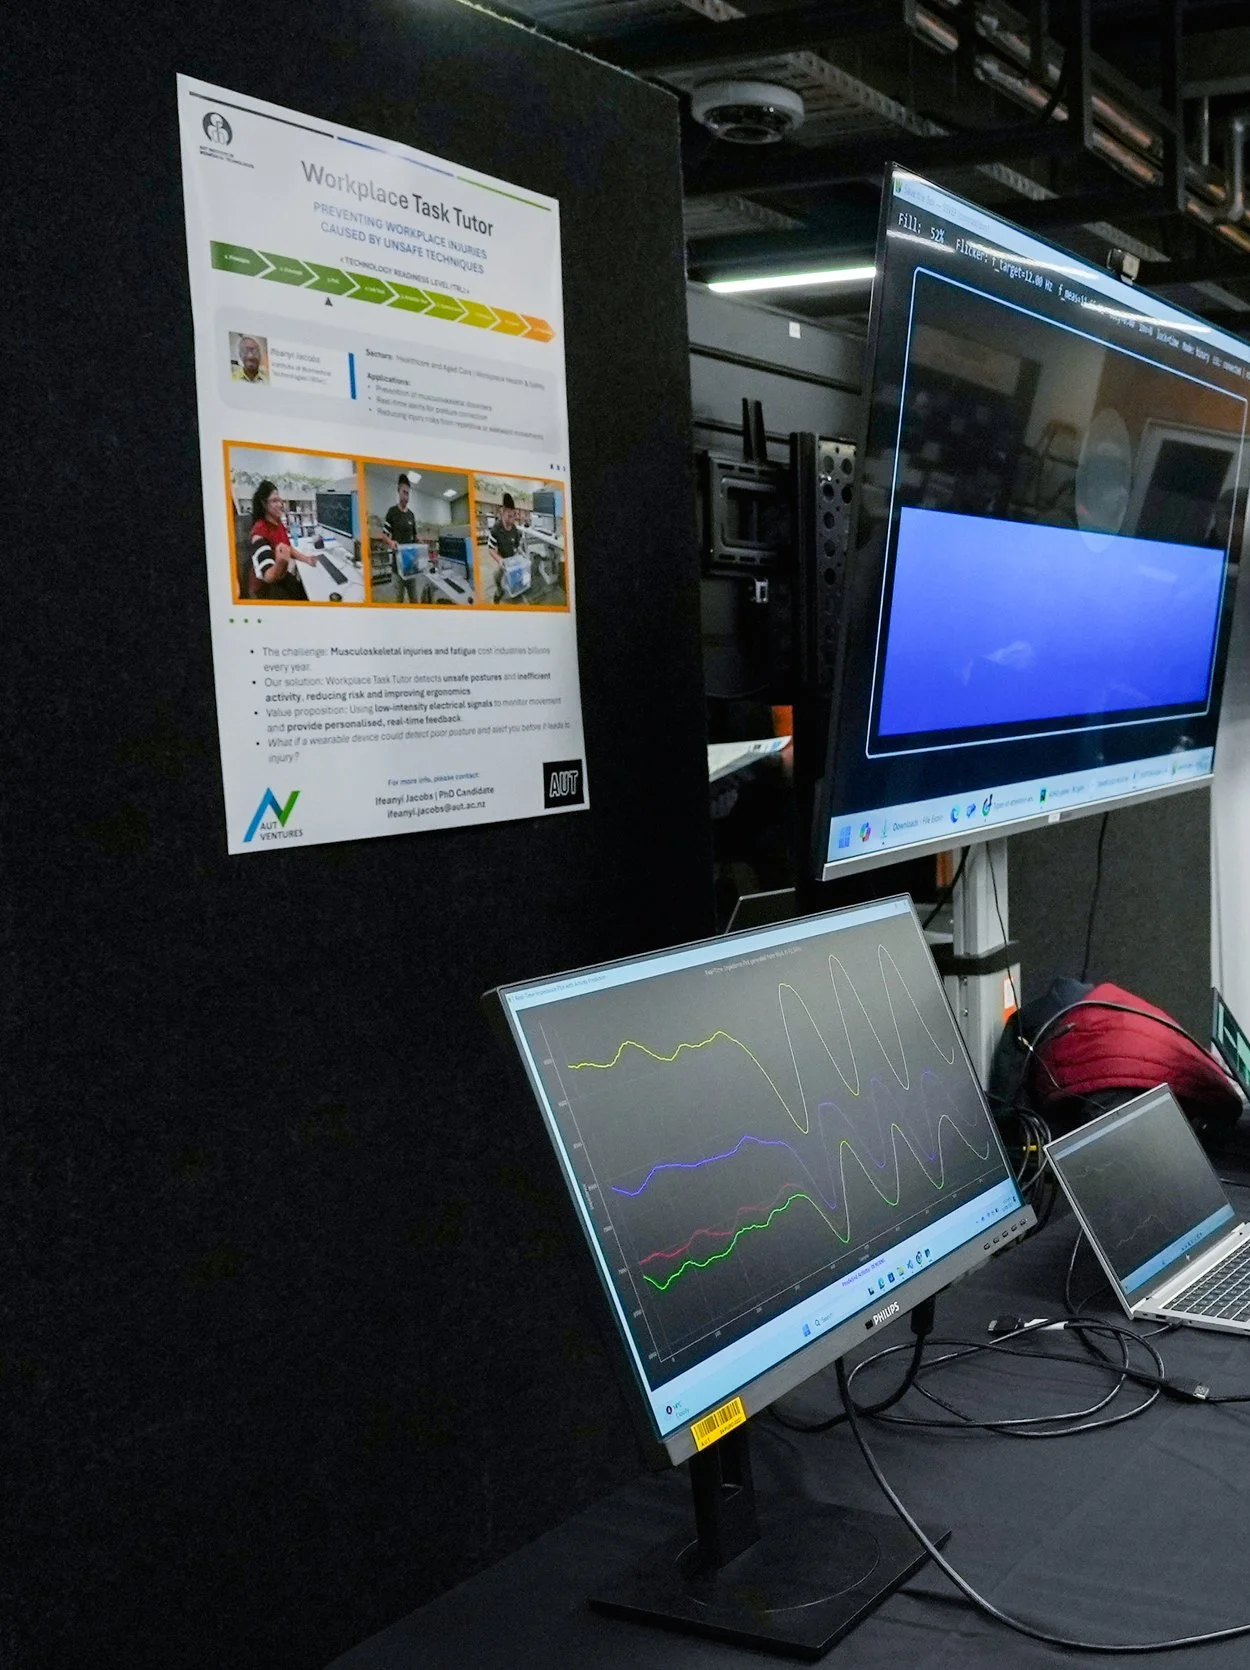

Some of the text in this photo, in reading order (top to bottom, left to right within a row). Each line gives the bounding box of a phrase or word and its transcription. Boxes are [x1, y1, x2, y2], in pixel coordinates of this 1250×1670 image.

[301, 160, 494, 236] Workplace Task Tutor
[313, 201, 487, 260] PREVENTING WORKPLACE INJURIES
[898, 212, 921, 234] Fill:
[930, 227, 945, 244] 52%
[321, 221, 485, 274] CAUSED BY UNSAFE TECHNIQUES
[263, 647, 280, 656] The
[282, 647, 327, 659] challenge:
[330, 647, 402, 656] Musculoskeletal
[403, 647, 433, 657] injuries
[435, 647, 449, 655] and
[450, 646, 477, 657] fatigue
[478, 647, 492, 655] cost
[264, 664, 288, 674] every
[264, 672, 551, 687] Our solution: Workplace Task Tutor detects unsafe postures and inefficient
[265, 688, 471, 703] activity, reducing risk and improving ergonomics
[266, 708, 291, 717] Value
[294, 706, 347, 718] proposition:
[349, 705, 373, 715] Using
[375, 702, 428, 712] low-intensity
[429, 701, 465, 710] electrical
[467, 700, 493, 710] signals
[267, 714, 461, 733] and provide personalised, real-time feedback
[268, 736, 293, 747] What
[302, 738, 308, 746] a
[309, 735, 350, 746] wearable
[351, 732, 379, 743] device
[381, 730, 404, 741] could
[405, 729, 429, 739] detect
[430, 729, 447, 739] poor
[449, 727, 476, 738] posture
[477, 726, 491, 735] and
[508, 725, 520, 734] you
[268, 751, 300, 764] injury?
[549, 770, 578, 797] AUT
[375, 796, 405, 806] Ifeanyi
[406, 793, 433, 803] Jacobs
[439, 789, 454, 799] PhD
[456, 786, 495, 797] Candidate
[260, 821, 277, 830] AUT
[260, 829, 303, 841] VENTURES
[873, 1301, 900, 1326] PHILIPS
